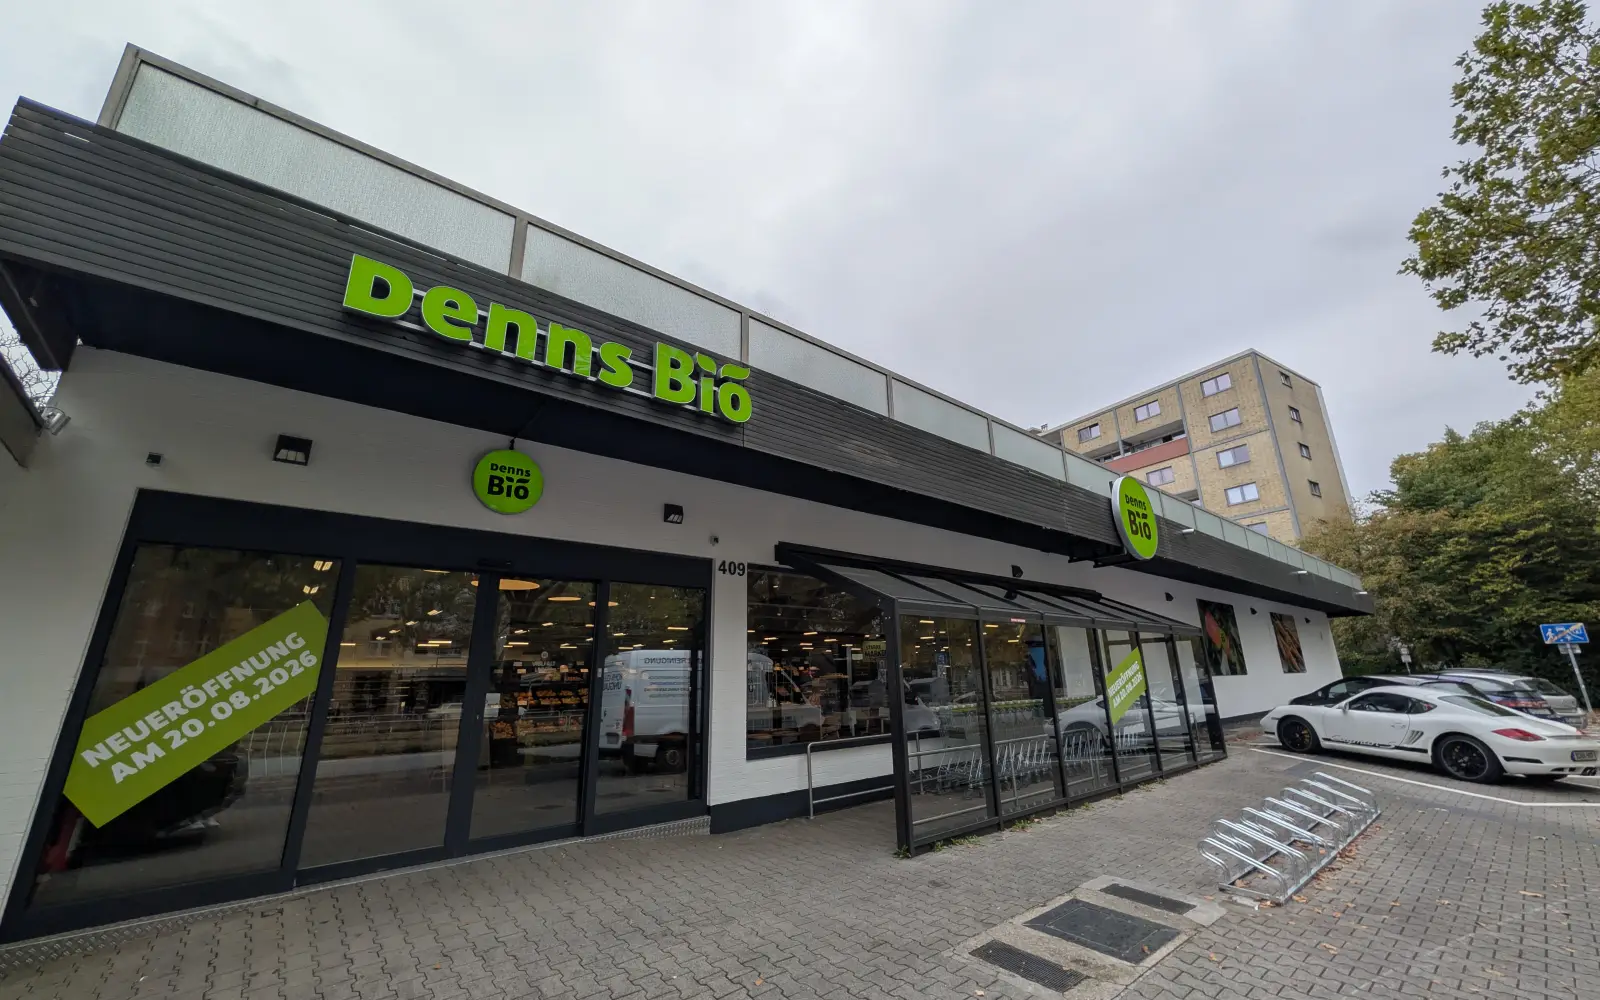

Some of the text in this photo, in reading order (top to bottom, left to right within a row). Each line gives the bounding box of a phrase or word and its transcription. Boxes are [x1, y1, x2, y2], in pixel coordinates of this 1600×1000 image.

[342, 254, 754, 423] Denns Bio
[489, 462, 532, 478] Denns
[486, 475, 531, 501] Bio
[1124, 493, 1148, 511] Denns
[1126, 508, 1152, 541] Bio
[717, 560, 746, 577] 409
[80, 631, 307, 768] NEUERÖFFNUNG
[111, 650, 318, 784] AM 20.08.2026
